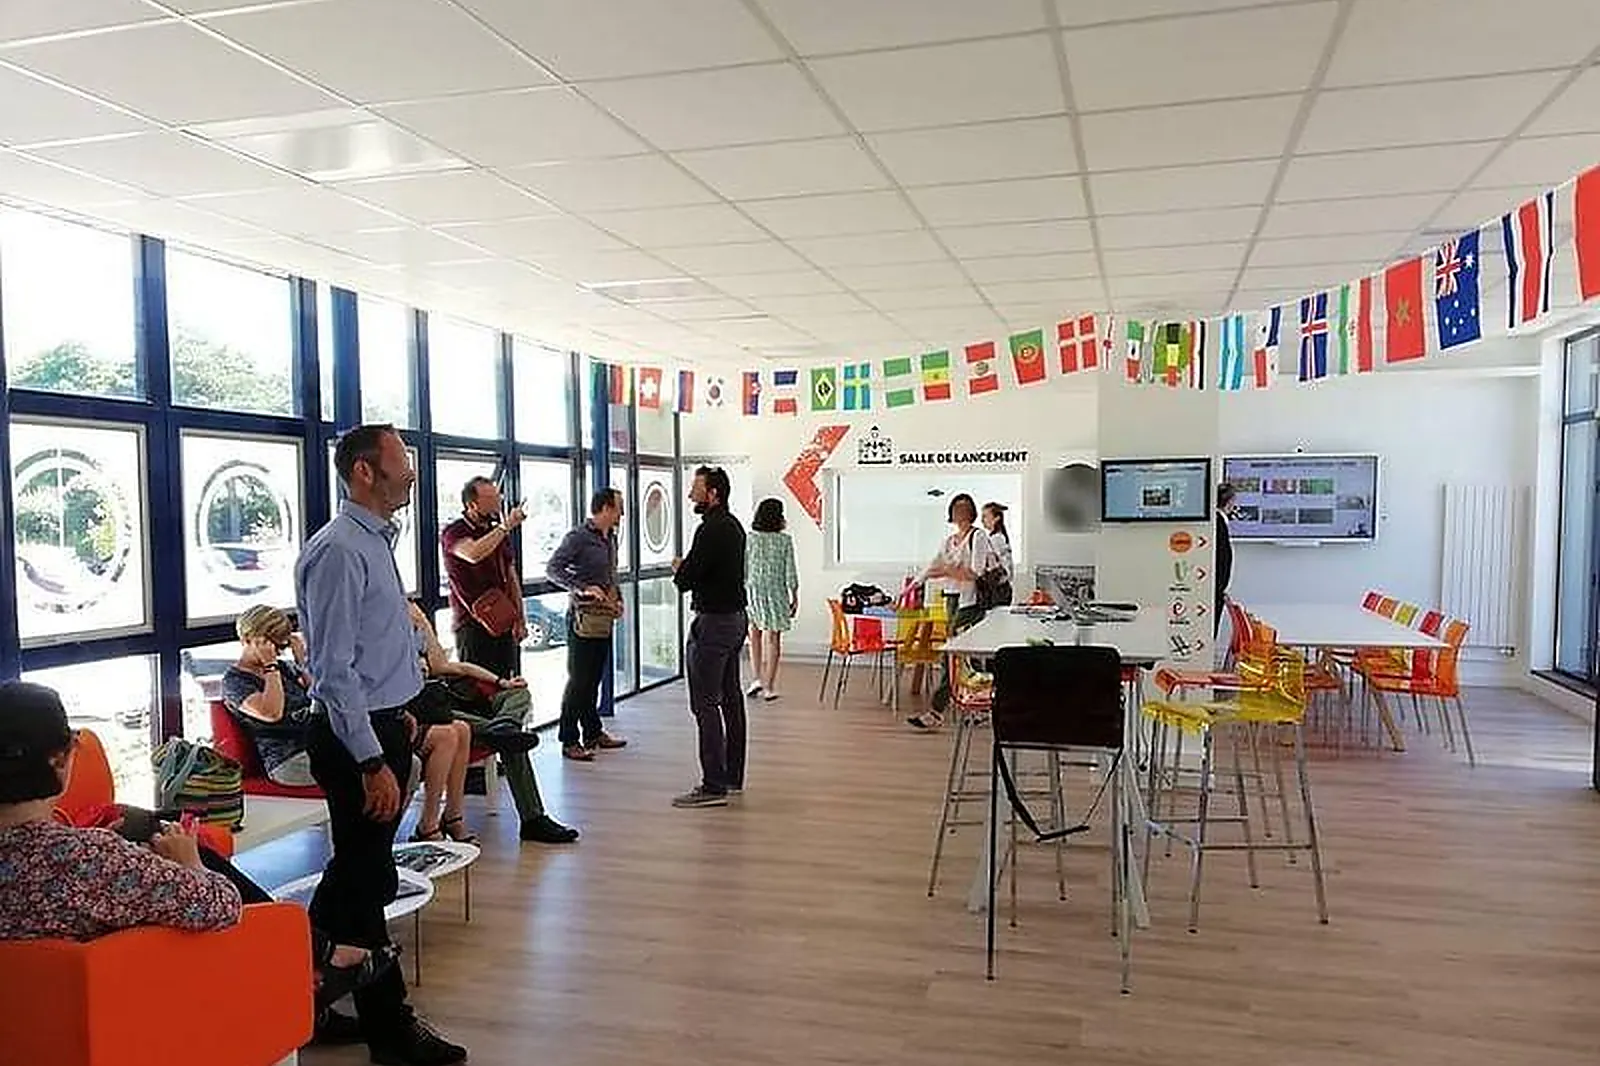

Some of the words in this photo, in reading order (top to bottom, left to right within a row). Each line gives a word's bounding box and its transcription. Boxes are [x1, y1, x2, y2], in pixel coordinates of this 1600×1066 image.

[899, 453, 935, 464] SALLE
[937, 453, 952, 463] DE
[954, 451, 1028, 463] LANCEMENT
